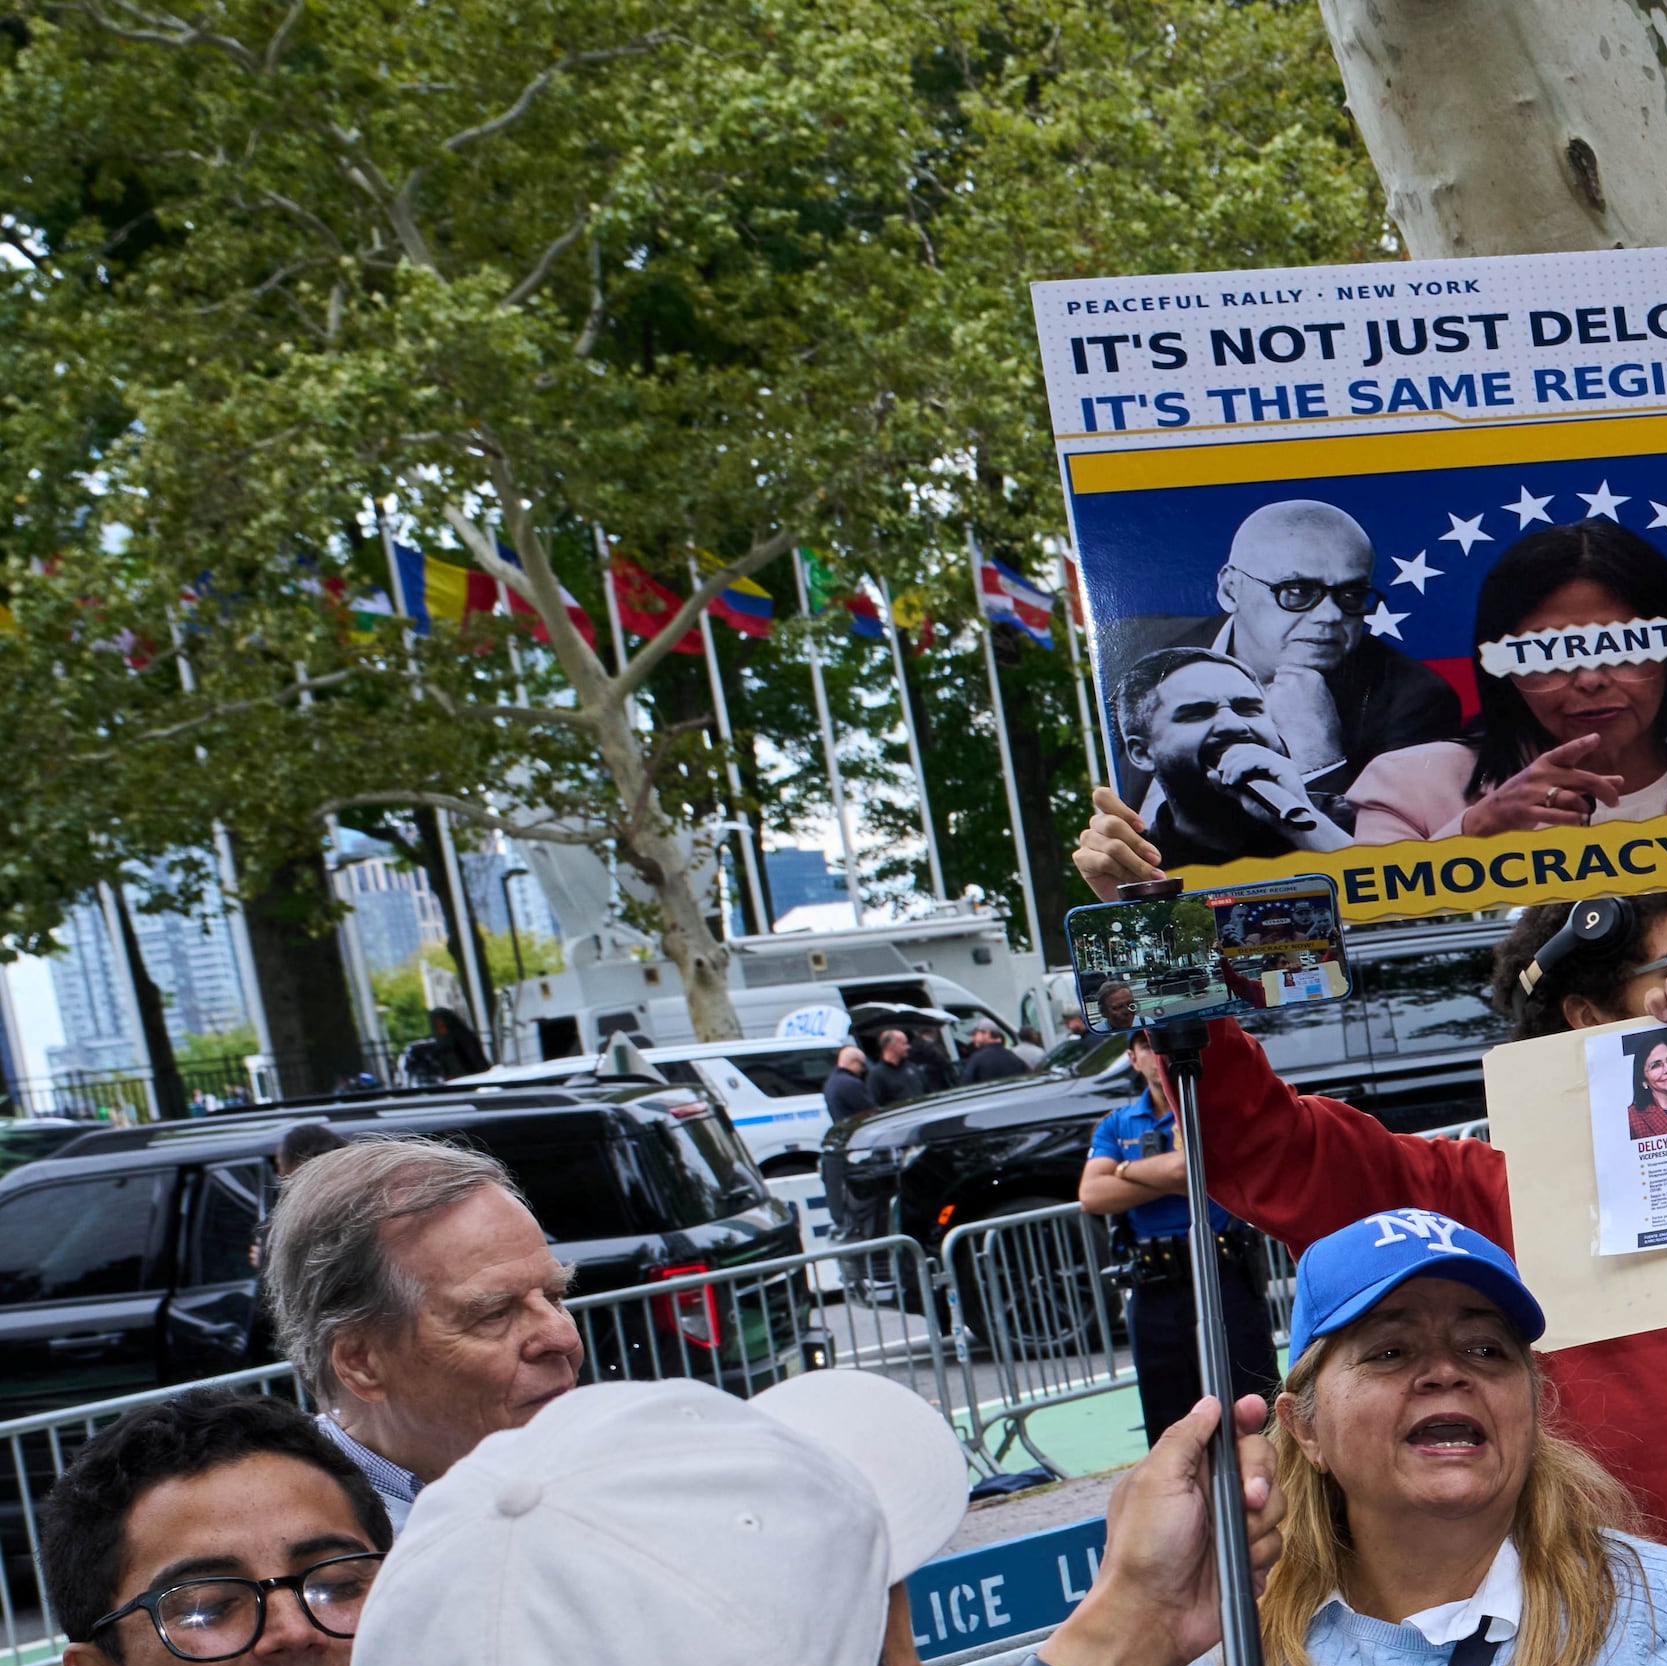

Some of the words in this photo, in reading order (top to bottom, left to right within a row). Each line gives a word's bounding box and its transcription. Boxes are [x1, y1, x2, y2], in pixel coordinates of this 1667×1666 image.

[1067, 292, 1211, 315] PEACEFUL
[1221, 289, 1305, 309] RALLY
[1336, 284, 1399, 302] NEW
[1407, 279, 1481, 298] YORK
[1072, 329, 1188, 376] IT'S
[1212, 321, 1346, 366] NOT
[1364, 313, 1510, 367] JUST
[1081, 389, 1190, 432] IT'S
[1206, 381, 1328, 425] THE
[1349, 370, 1514, 416] SAME
[1638, 1139, 1667, 1153] DELCY
[1364, 1207, 1470, 1255] NY
